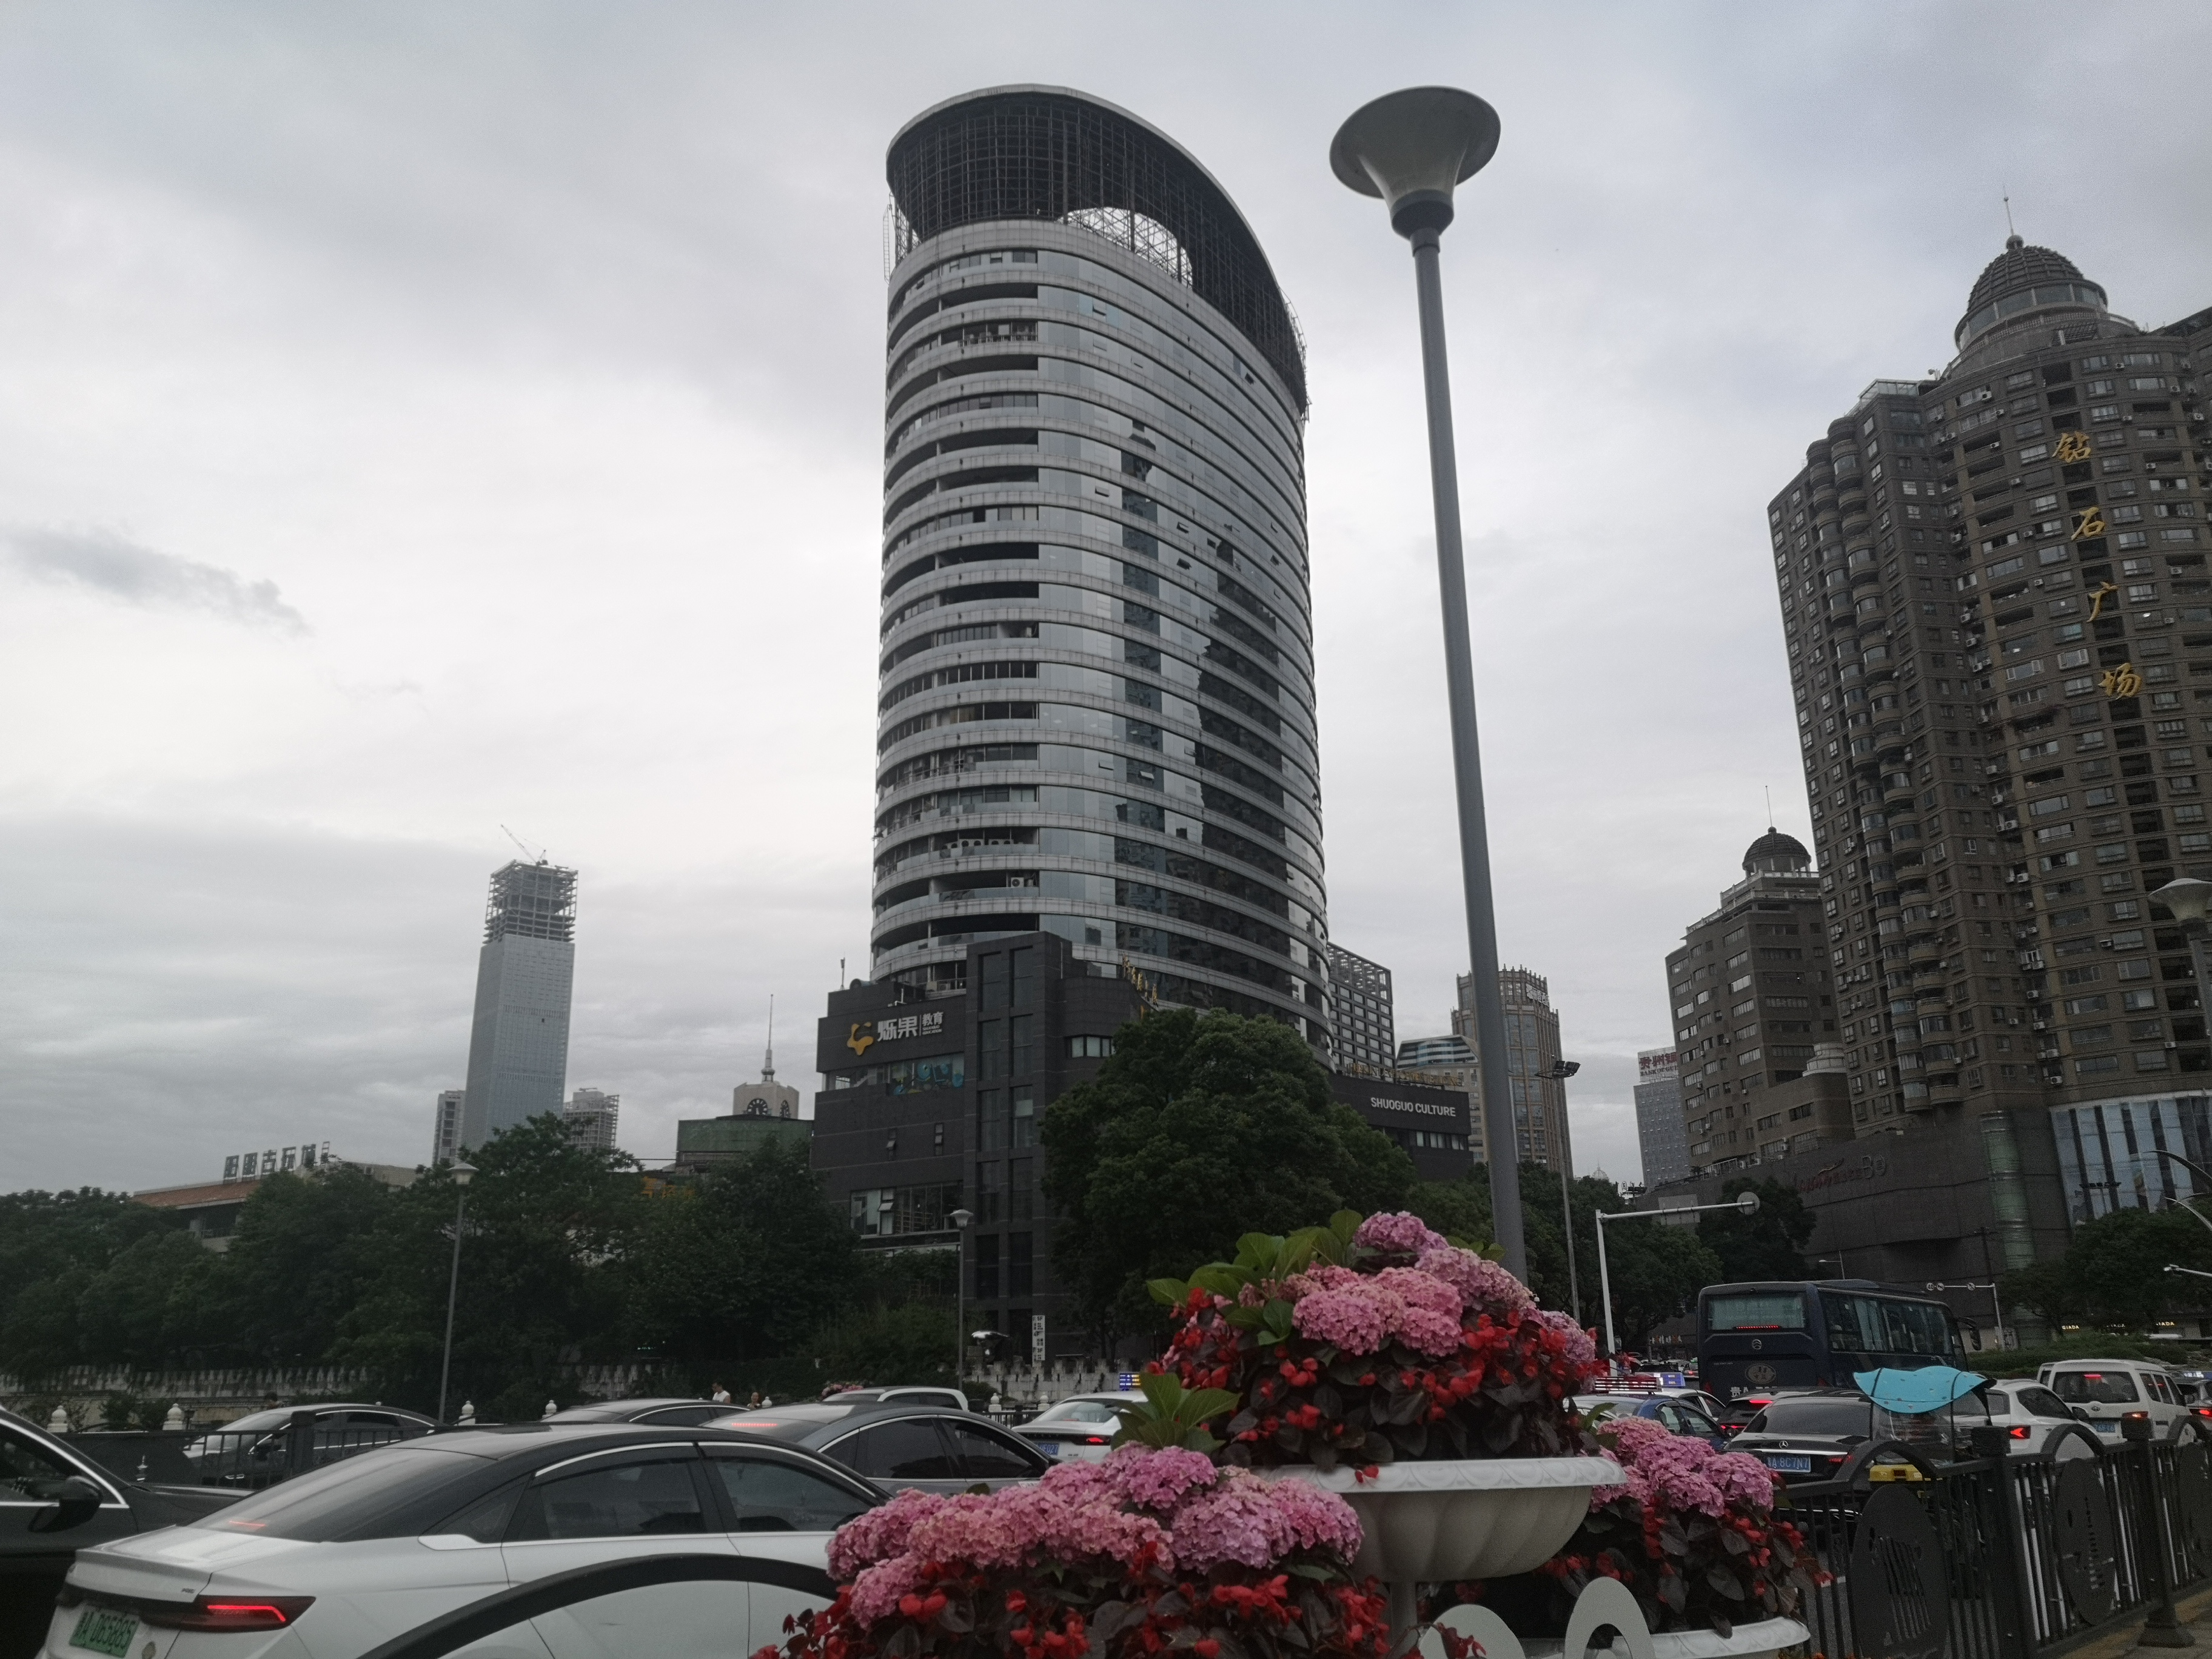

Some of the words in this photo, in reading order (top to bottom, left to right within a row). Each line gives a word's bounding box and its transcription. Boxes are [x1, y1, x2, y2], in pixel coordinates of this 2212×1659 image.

[2052, 431, 2143, 700] 钻石广场
[877, 1016, 918, 1042] 烁果
[922, 1011, 944, 1027] 教育
[1370, 1097, 1413, 1112] SHUOGUO
[1415, 1103, 1456, 1117] CULTURE
